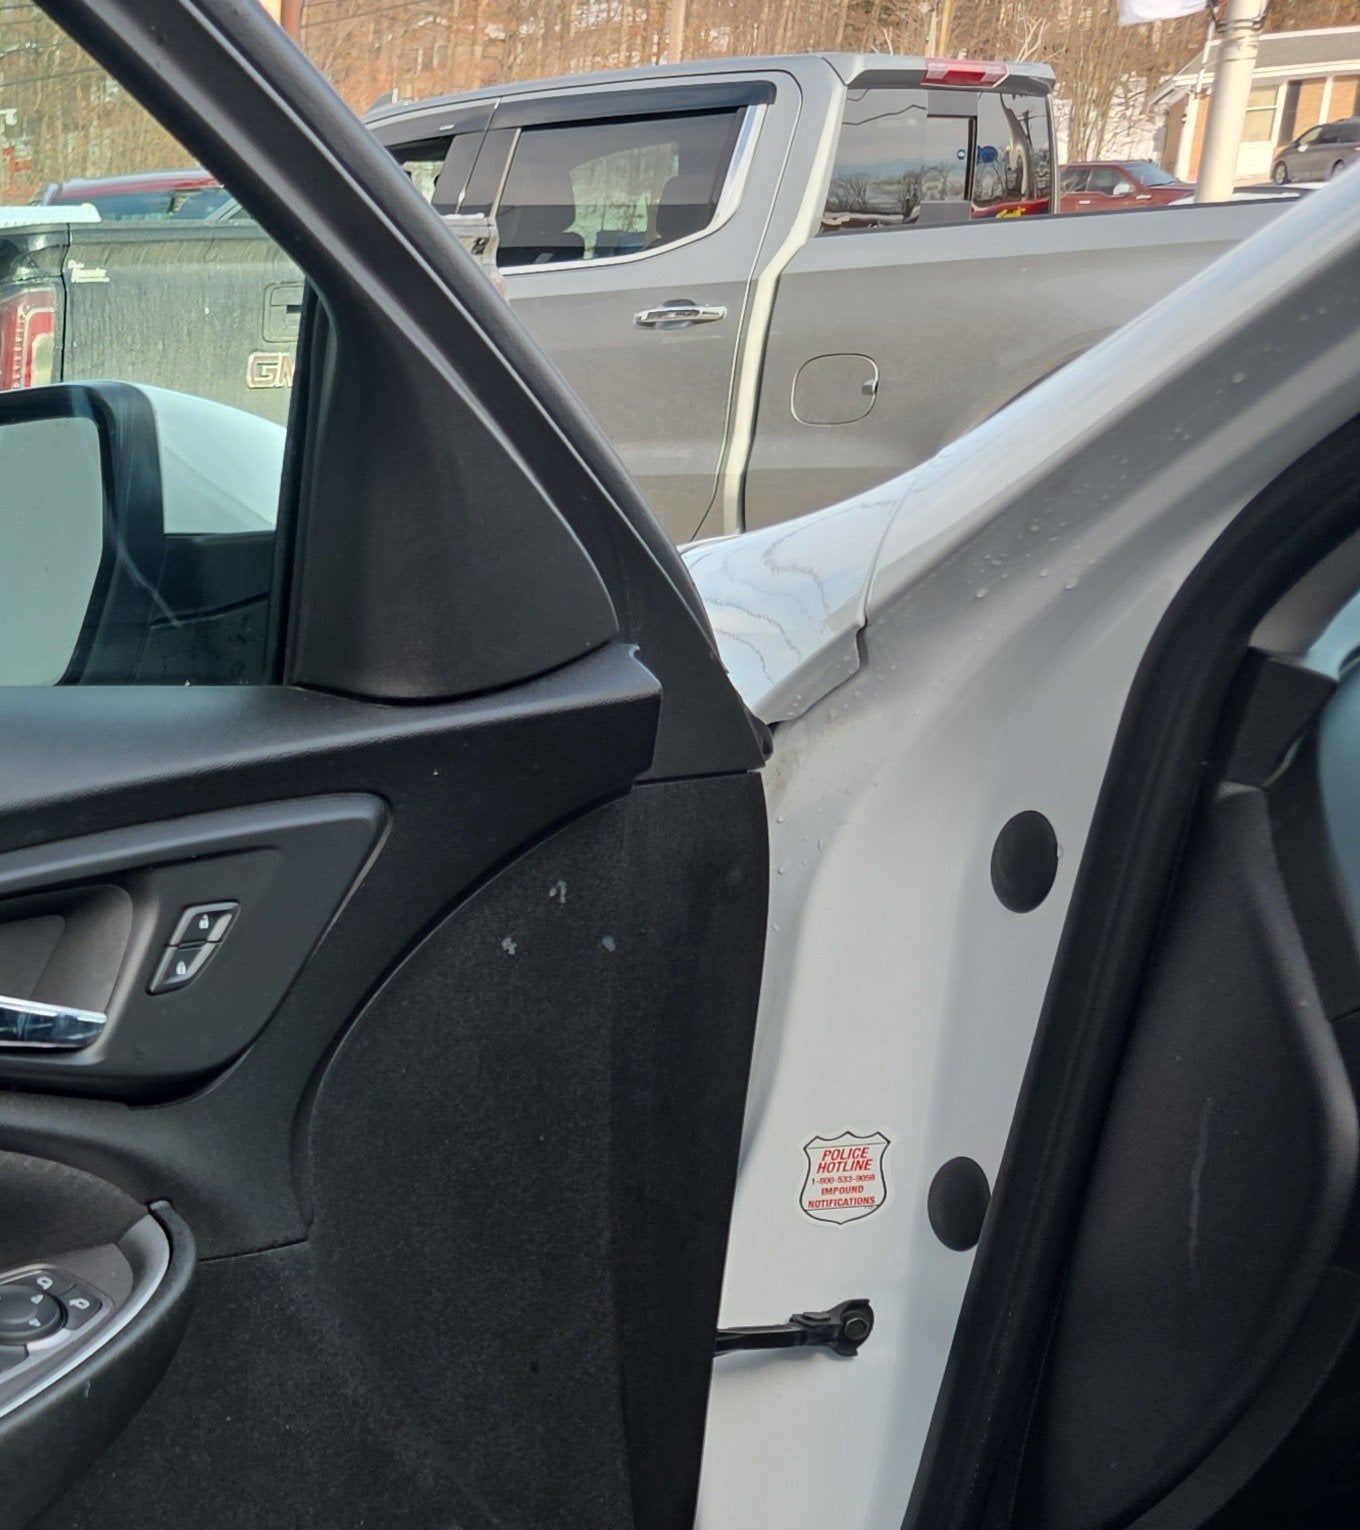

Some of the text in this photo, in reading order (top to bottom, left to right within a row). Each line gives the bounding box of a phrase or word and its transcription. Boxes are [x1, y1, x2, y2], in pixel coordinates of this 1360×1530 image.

[821, 1147, 870, 1162] POLICE
[816, 1159, 874, 1175] HOTLINE
[821, 1185, 865, 1196] IMPOUND
[807, 1196, 877, 1209] NOTIFICATIONS
